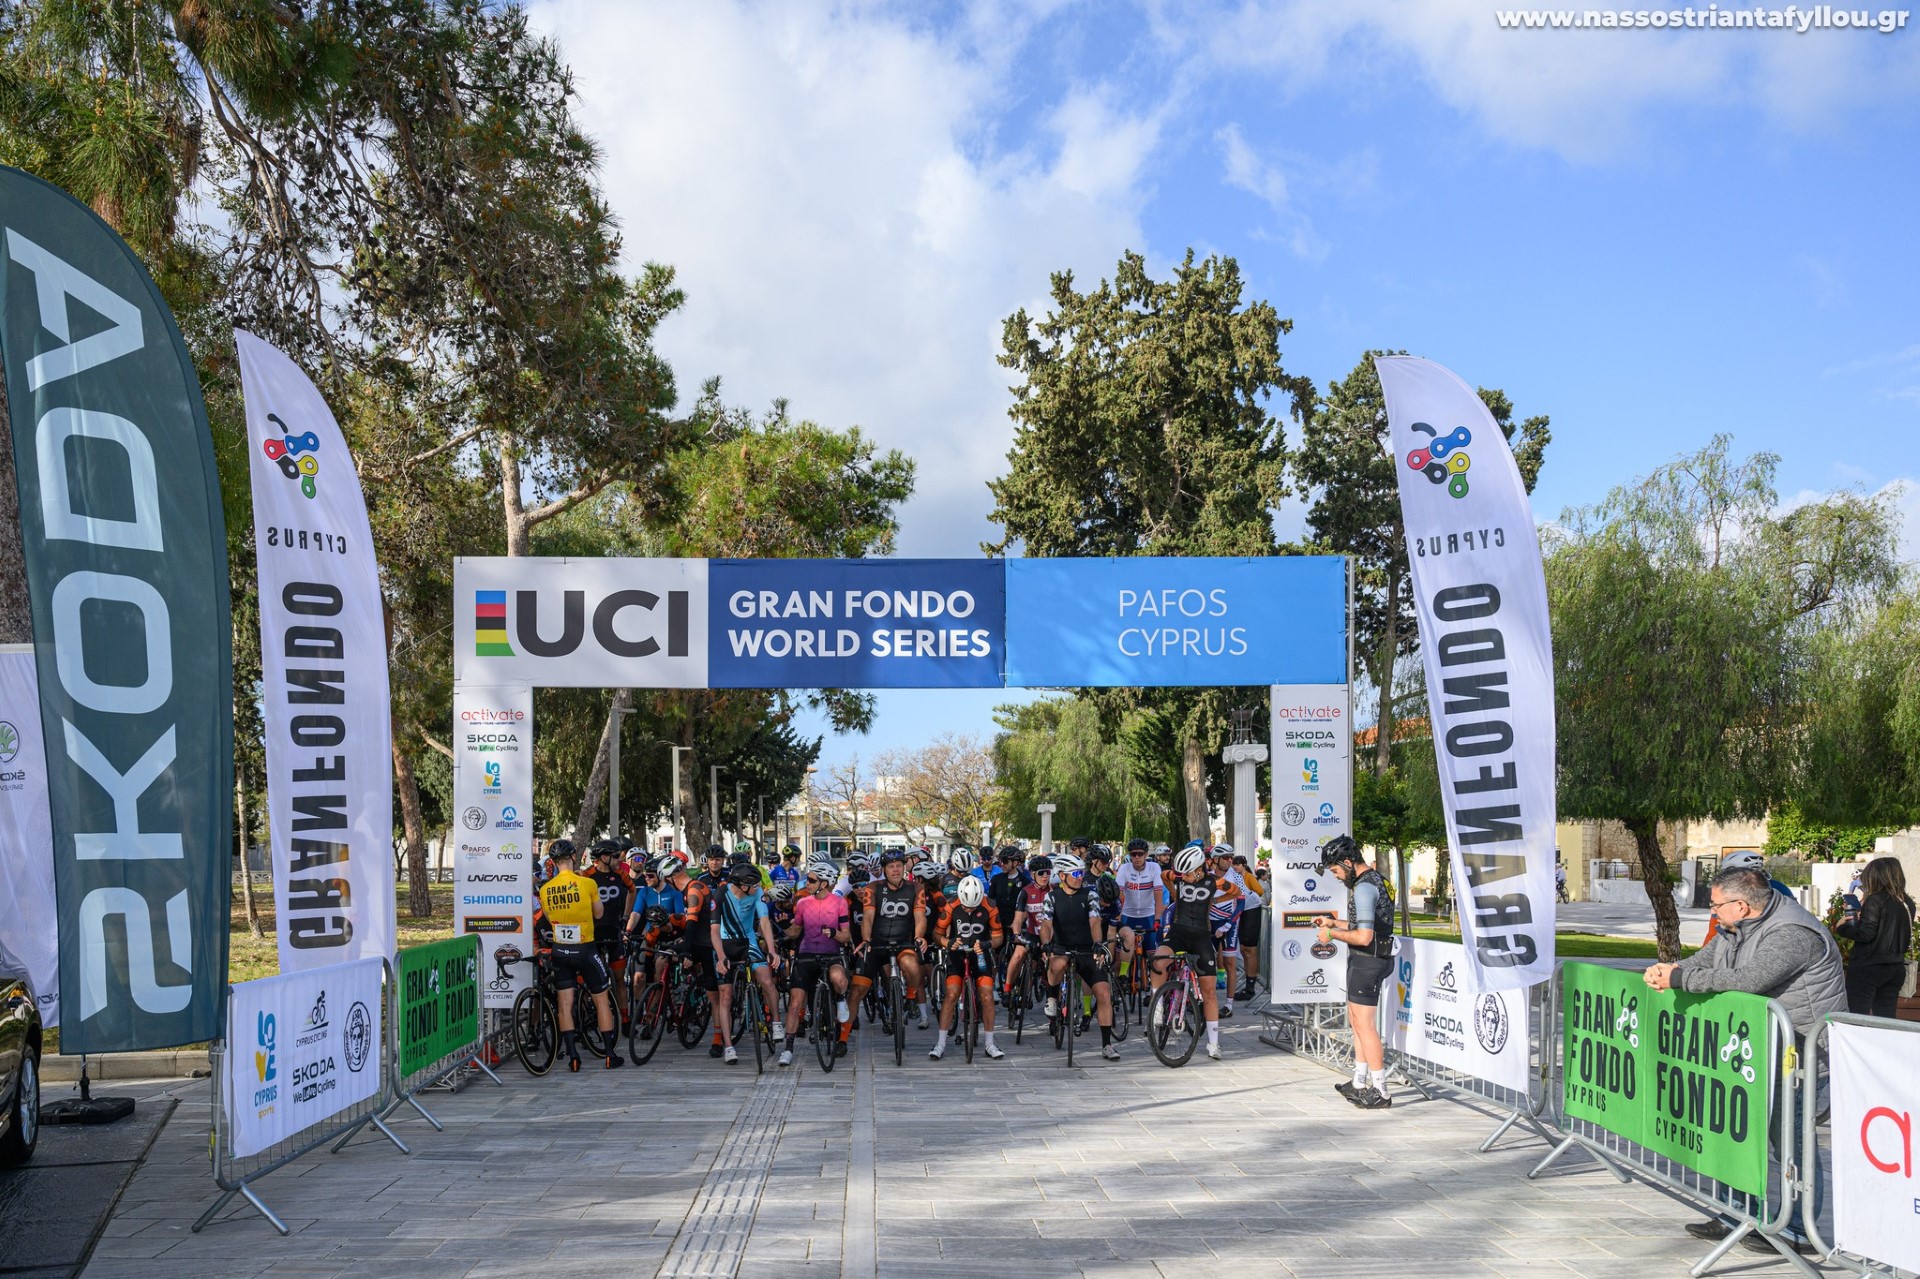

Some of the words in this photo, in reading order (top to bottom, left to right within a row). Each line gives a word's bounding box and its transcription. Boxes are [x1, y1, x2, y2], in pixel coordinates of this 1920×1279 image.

[729, 590, 833, 619] GRAN
[845, 590, 975, 619] FONDO
[1119, 589, 1227, 617] PAFOS
[516, 589, 689, 658] UCI
[729, 629, 860, 658] WORLD
[871, 629, 990, 658] SERIES
[1118, 627, 1247, 656] CYPRUS
[461, 709, 524, 721] activate
[1280, 706, 1341, 718] activate
[467, 734, 518, 743] SKODA
[1286, 731, 1335, 739] SKODA
[496, 820, 524, 828] atlantic
[1313, 816, 1340, 824] atlantic
[1287, 838, 1309, 846] PAFOS
[463, 895, 523, 905] SHIMANO
[547, 886, 567, 895] GRAN
[547, 893, 580, 906] FONDO
[561, 929, 573, 939] 12
[446, 955, 467, 989] GRAN
[407, 966, 429, 1005] GRAN
[446, 984, 474, 1027] FONDO
[1573, 989, 1615, 1038] GRAN
[406, 999, 438, 1046] FONDO
[1425, 1013, 1464, 1035] SKODA
[296, 1034, 313, 1048] CYPRUS
[313, 1029, 328, 1044] CYCLING
[1425, 1030, 1432, 1039] We
[1446, 1037, 1464, 1051] Cycling
[1658, 1009, 1719, 1070] GRAN
[293, 1056, 335, 1087] SKODA
[1569, 1034, 1636, 1100] FONDO
[255, 1085, 277, 1107] CYPRUS
[293, 1092, 302, 1104] We
[318, 1079, 335, 1096] Cycling
[1566, 1083, 1606, 1112] CYPRUS
[1656, 1061, 1748, 1143] FONDO
[1656, 1116, 1703, 1155] CYPRUS
